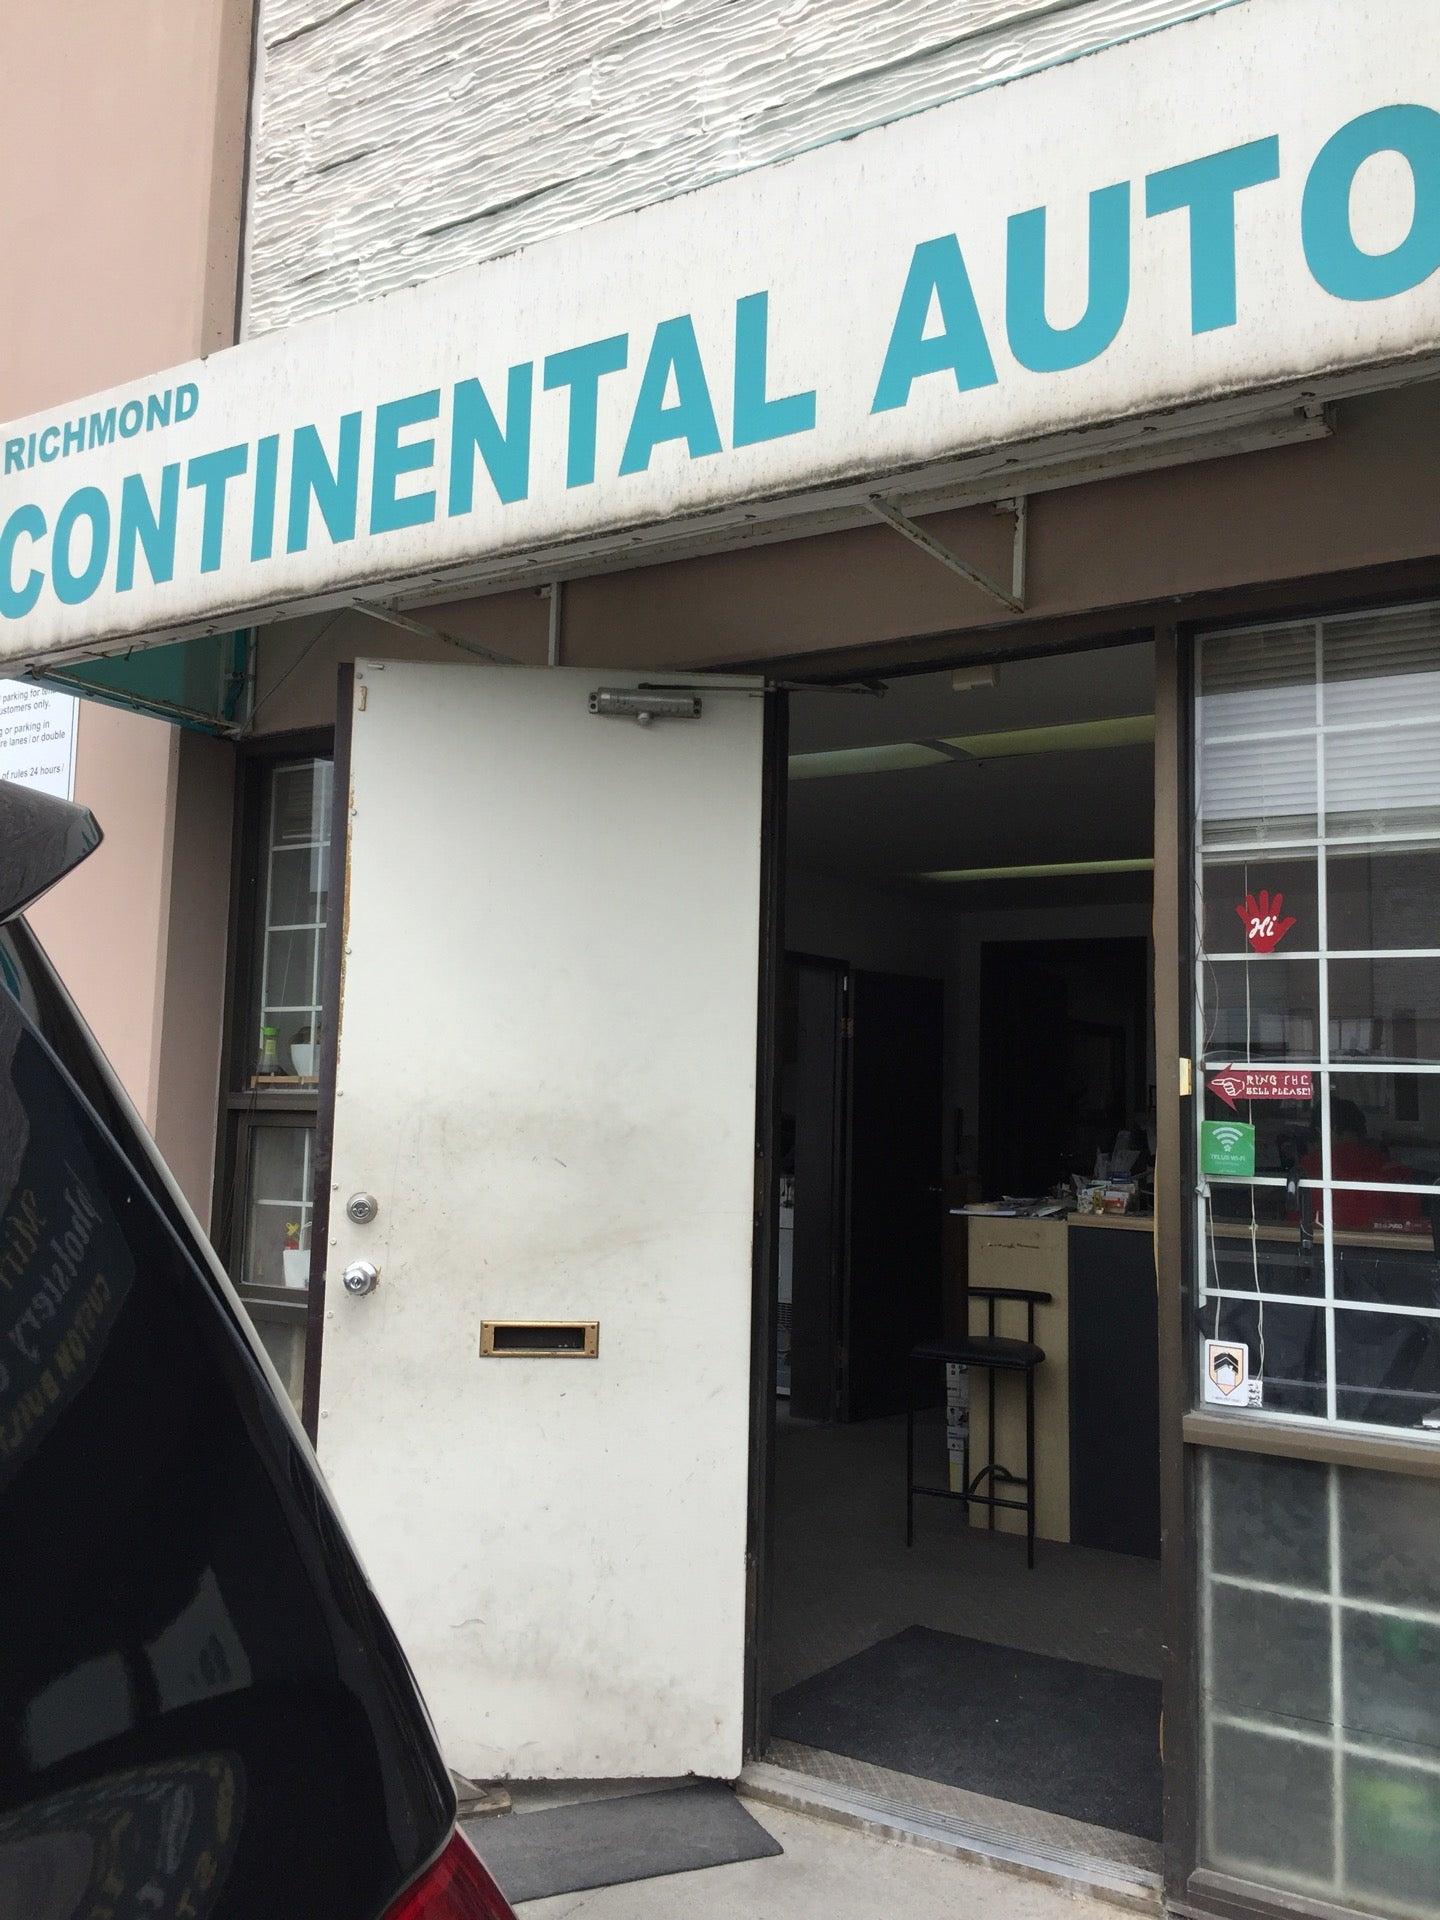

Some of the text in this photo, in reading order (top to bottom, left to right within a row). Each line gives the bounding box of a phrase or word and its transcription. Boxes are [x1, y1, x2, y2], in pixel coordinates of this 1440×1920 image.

[0, 104, 1440, 619] CONTINENTAL AUTO
[4, 382, 199, 475] RICHMOND
[3, 691, 28, 704] parking
[30, 688, 40, 698] for
[4, 726, 13, 735] or
[14, 722, 41, 735] parking
[42, 720, 50, 729] in
[9, 736, 28, 746] lanes
[31, 734, 39, 743] or
[41, 730, 66, 742] double
[2, 769, 10, 779] of
[10, 768, 28, 779] rules
[29, 767, 39, 777] 24
[40, 764, 60, 776] hours
[1249, 915, 1278, 939] Hi
[1246, 1074, 1277, 1086] RING
[1246, 1087, 1270, 1096] BELL
